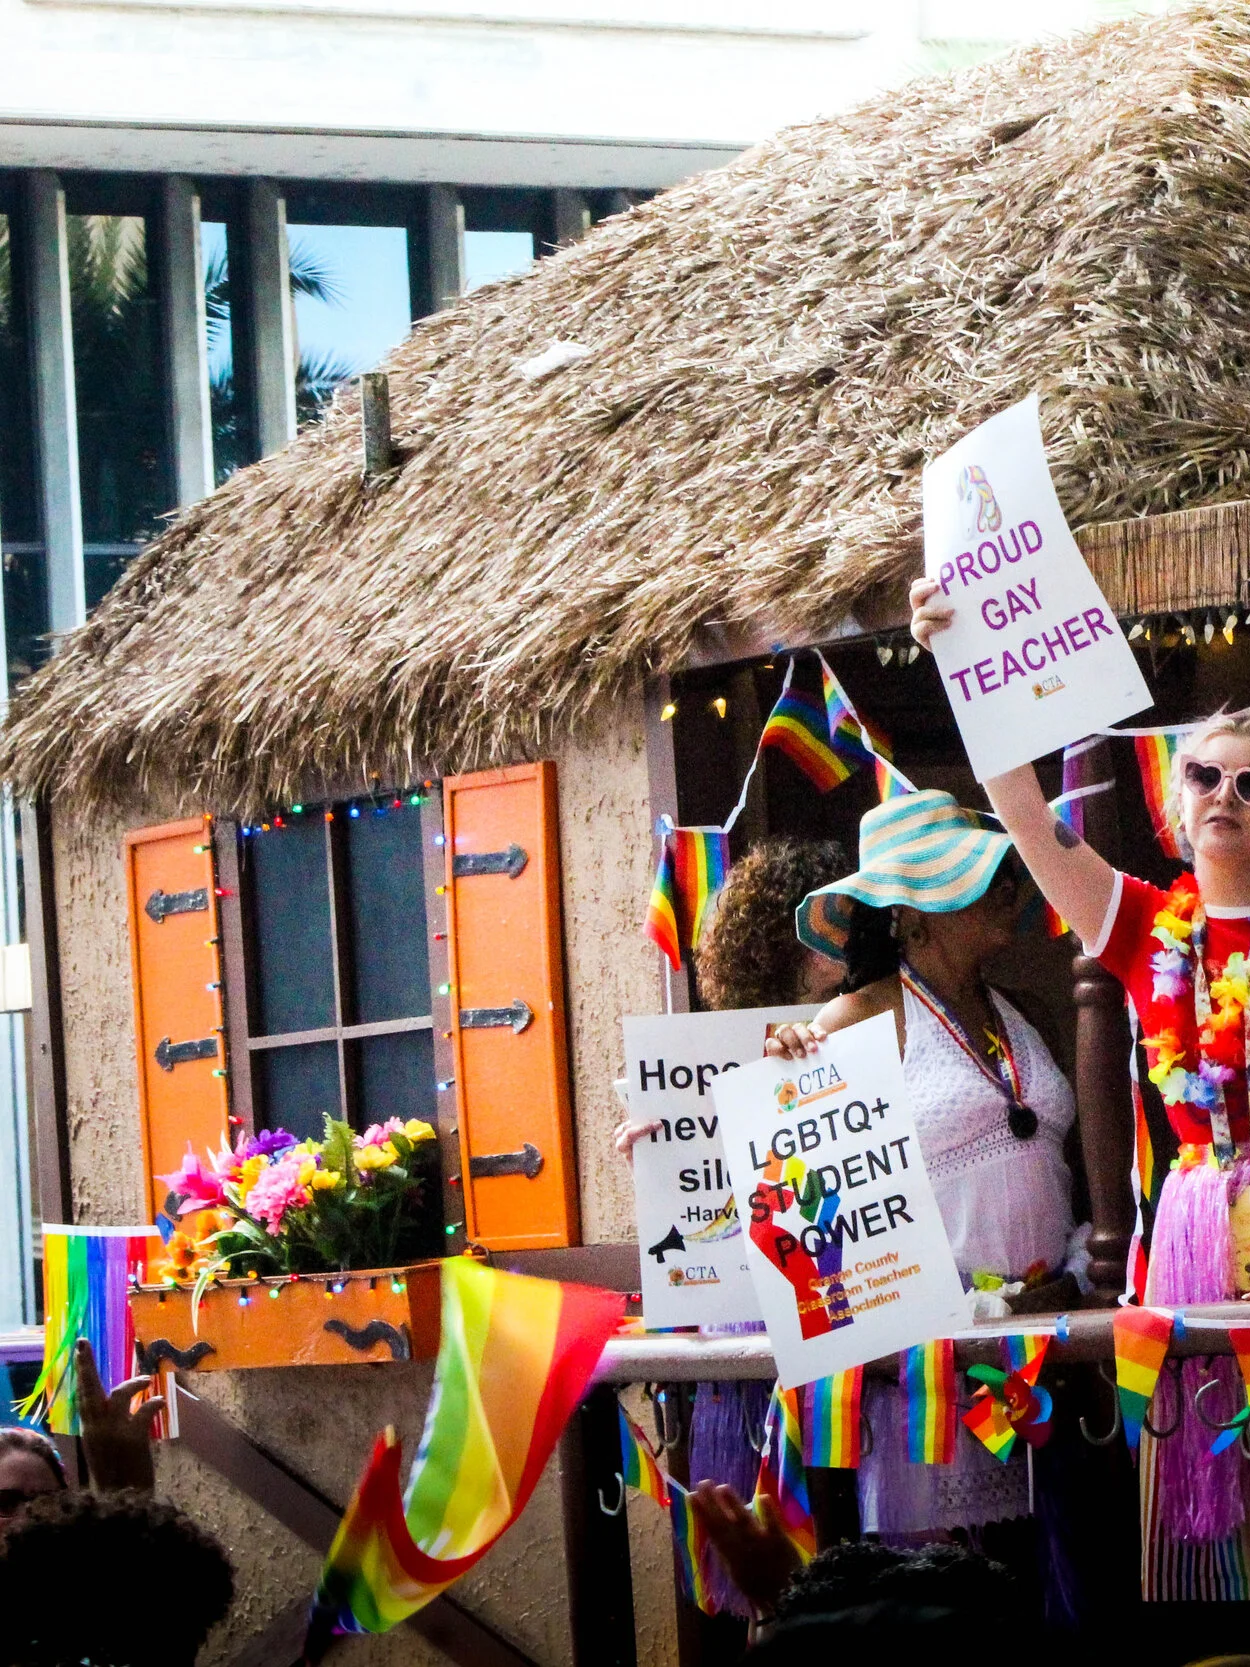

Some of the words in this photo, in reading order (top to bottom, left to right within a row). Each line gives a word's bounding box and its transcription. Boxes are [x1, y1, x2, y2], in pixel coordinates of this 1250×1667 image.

[939, 520, 1043, 596] PROUD
[981, 577, 1042, 631] GAY
[949, 607, 1114, 701] TEACHER
[749, 1096, 890, 1171] LGBTQ+
[679, 1158, 732, 1192] sil
[748, 1136, 911, 1223] STUDENT
[680, 1205, 739, 1222] -Harv
[775, 1194, 914, 1268] POWER
[798, 1285, 863, 1314] Classroom
[865, 1263, 921, 1290] Teachers
[808, 1268, 853, 1291] Orange
[855, 1250, 899, 1275] County
[829, 1290, 901, 1323] Association
